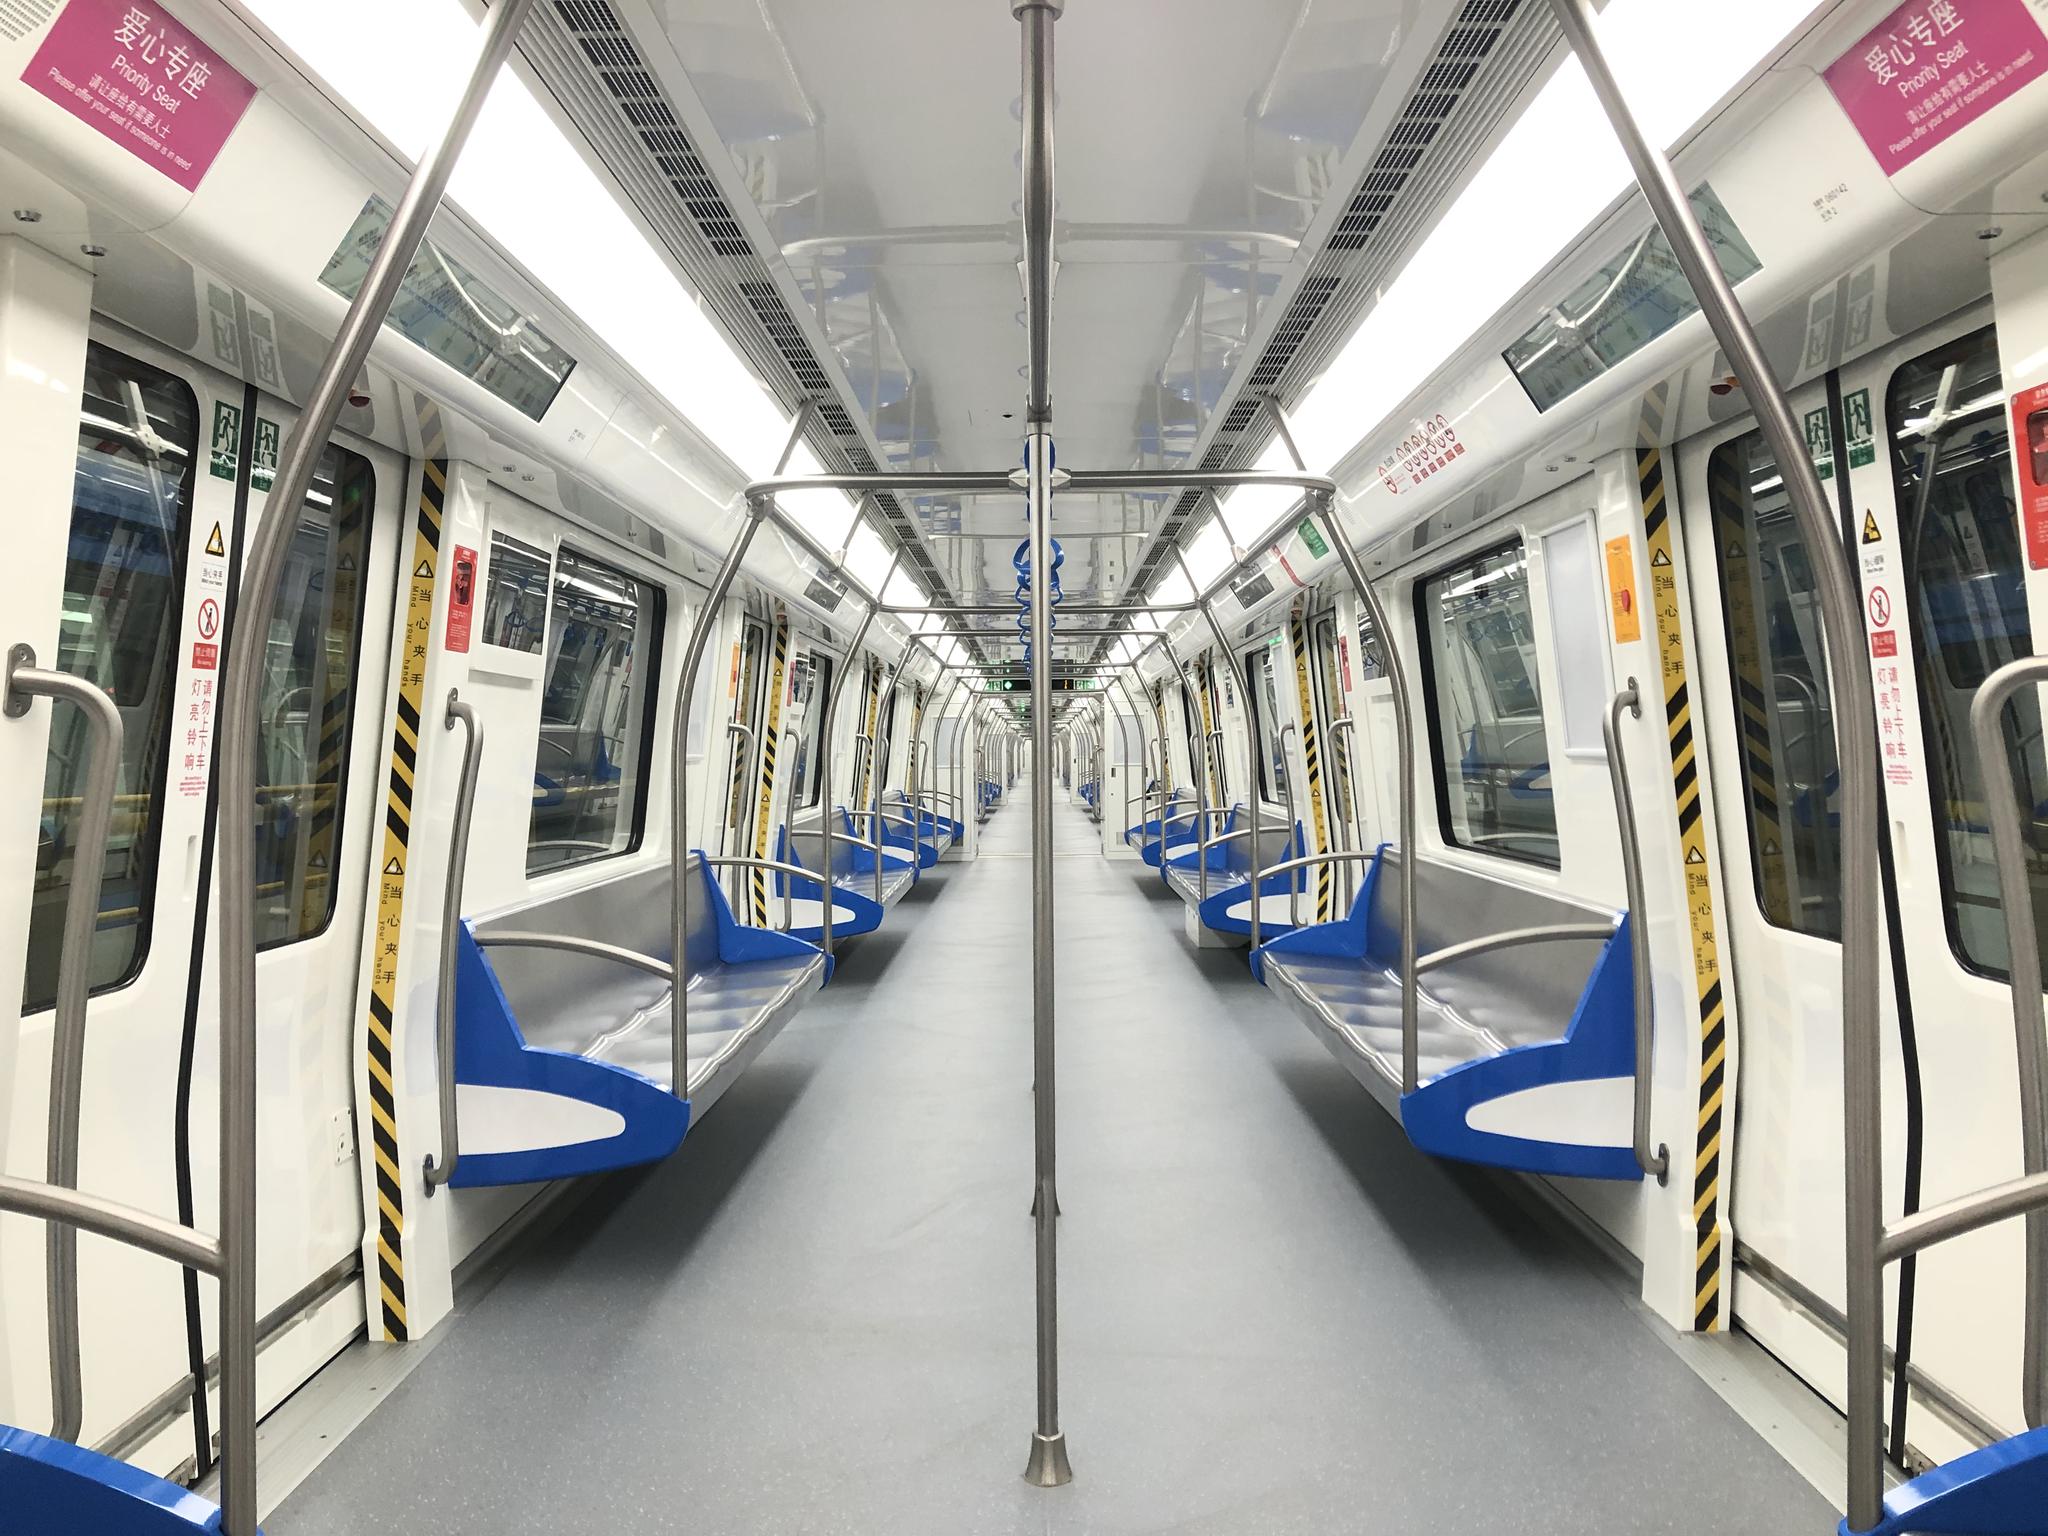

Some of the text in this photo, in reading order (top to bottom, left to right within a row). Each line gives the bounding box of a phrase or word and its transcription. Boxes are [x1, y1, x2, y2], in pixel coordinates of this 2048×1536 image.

[111, 54, 182, 114] Priority Seat
[114, 6, 213, 100] 爱心专座
[1864, 0, 1965, 86] 爱心专座
[1897, 39, 1969, 98] Priority Seat
[48, 66, 77, 93] Please
[74, 86, 95, 104] offer
[90, 99, 110, 116] your
[108, 110, 127, 127] seat
[129, 125, 162, 151] someone
[174, 155, 193, 171] need
[87, 73, 173, 139] 请让座给有需要人士
[401, 585, 419, 687] Mind your hands
[410, 588, 432, 687] 当心夹手
[1654, 575, 1671, 678] Mind your hands
[1661, 576, 1684, 674] 当心夹手
[184, 678, 202, 771] 灯亮铃响
[196, 679, 213, 771] 请勿上下车
[381, 882, 390, 905] Mind
[1688, 873, 1696, 895] Mind
[1695, 874, 1718, 973] 当心夹手
[375, 957, 384, 985] hands
[382, 886, 402, 984] 当心夹手
